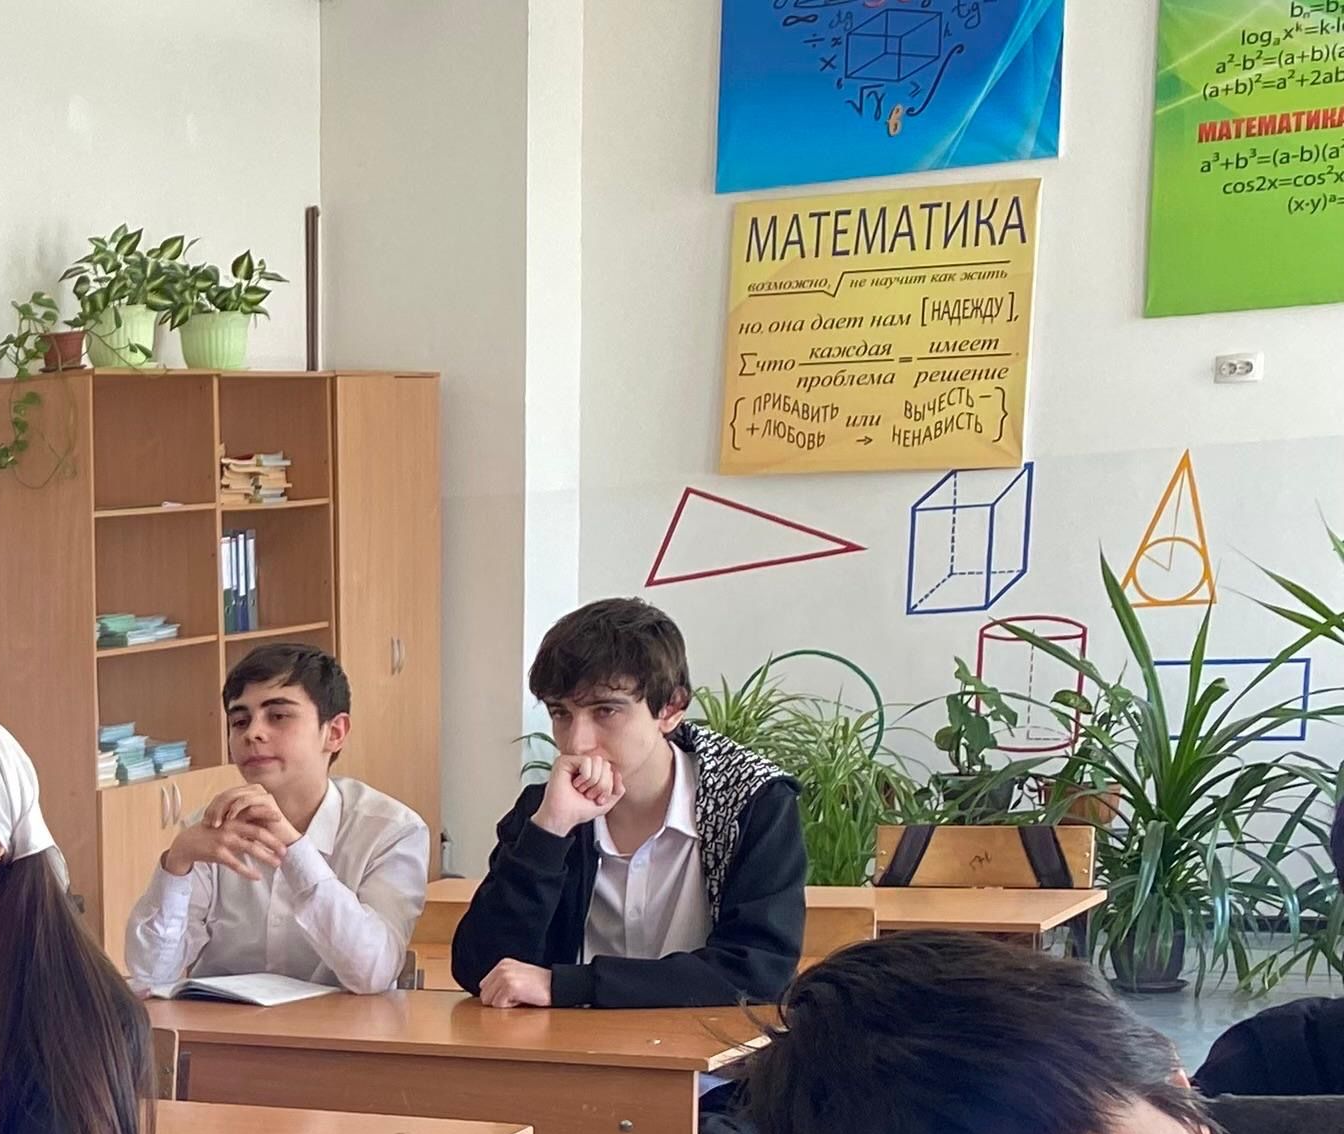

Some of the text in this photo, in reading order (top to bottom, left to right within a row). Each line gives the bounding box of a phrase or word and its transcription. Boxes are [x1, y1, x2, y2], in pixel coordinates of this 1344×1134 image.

[745, 196, 1027, 263] МАТЕМАТИКА
[748, 268, 1008, 293] возможно, не научит как жить
[768, 318, 805, 333] она
[810, 313, 865, 331] дает
[869, 312, 912, 328] нам
[808, 336, 1000, 360] каждая имеет
[796, 366, 1010, 393] проблема решение
[752, 386, 975, 428] ПРИБАВИТЬ или ВЫЧЕСТЬ
[891, 411, 984, 448] НЕНАВИСТЬ
